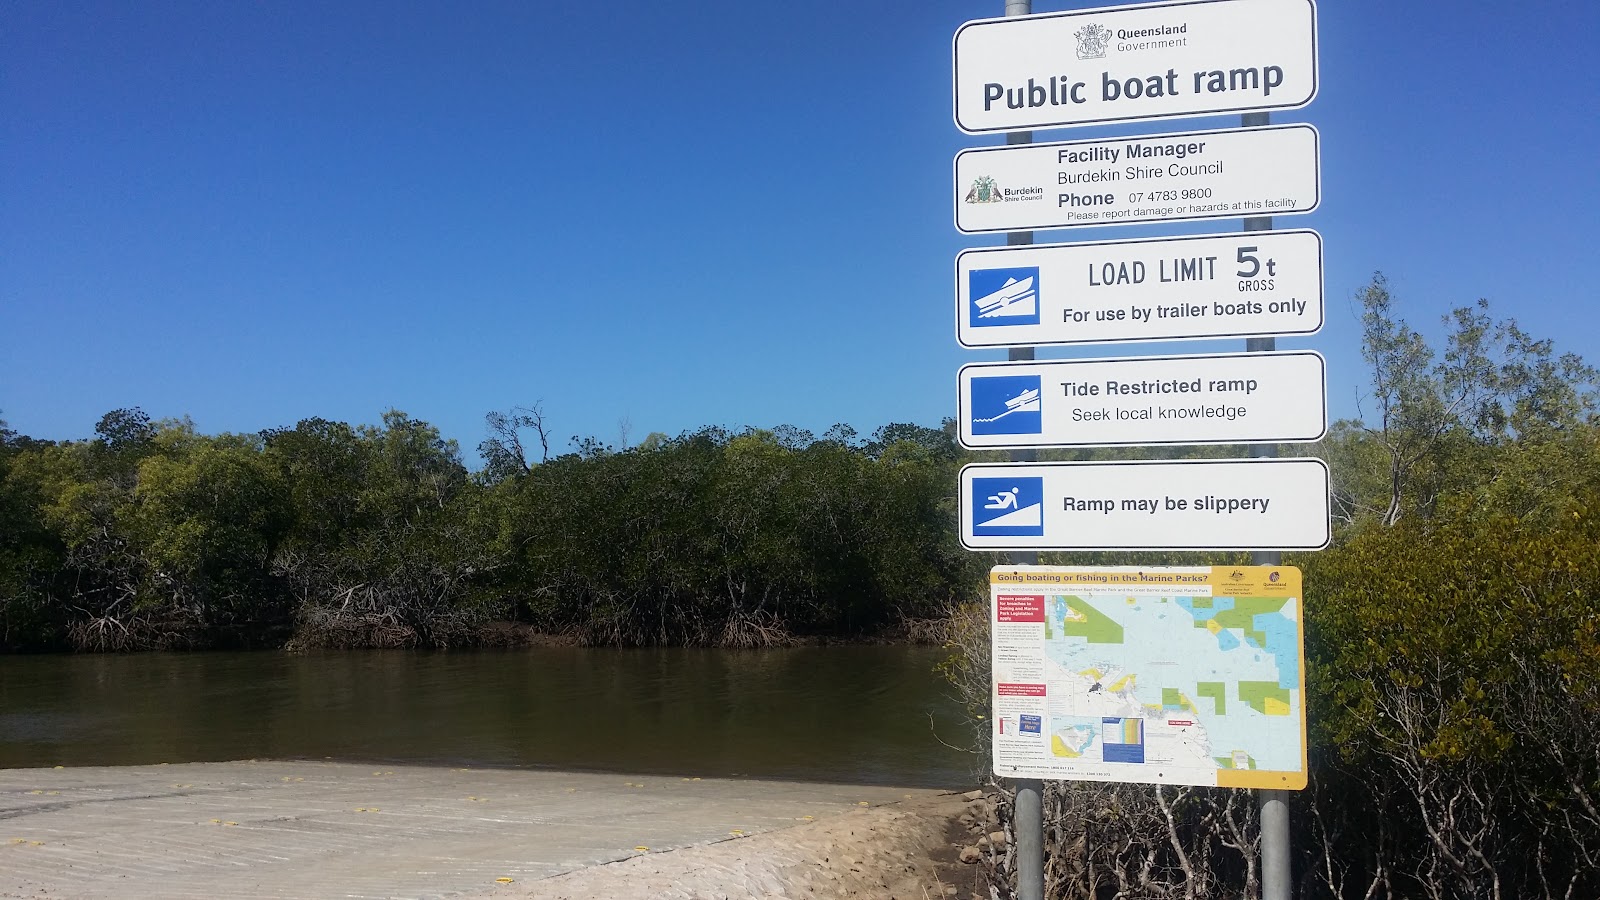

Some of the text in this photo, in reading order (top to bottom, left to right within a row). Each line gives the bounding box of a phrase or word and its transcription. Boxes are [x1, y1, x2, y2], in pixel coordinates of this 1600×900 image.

[1117, 23, 1187, 39] Queensland
[1117, 37, 1187, 52] Government
[984, 66, 1283, 111] Public boat ramp
[1058, 141, 1206, 164] Facility Manager
[1058, 161, 1224, 184] Burdekin Shire Council
[1005, 186, 1042, 197] Burdekin
[1059, 188, 1211, 207] Phone 07 4783 9800
[1067, 197, 1297, 220] Please report damage or hazards at this facility
[1089, 246, 1276, 286] LOAD LIMIT 5 t
[1238, 279, 1274, 292] GROSS
[1064, 298, 1306, 323] For use by trailer boats only
[1061, 378, 1257, 396] Tide Restricted ramp
[1072, 404, 1246, 421] Seek local knowledge
[1064, 496, 1269, 514] Ramp may be slippery
[998, 574, 1023, 582] Going
[1027, 574, 1060, 582] boating
[1076, 574, 1107, 583] fishing
[1139, 574, 1172, 582] Marine
